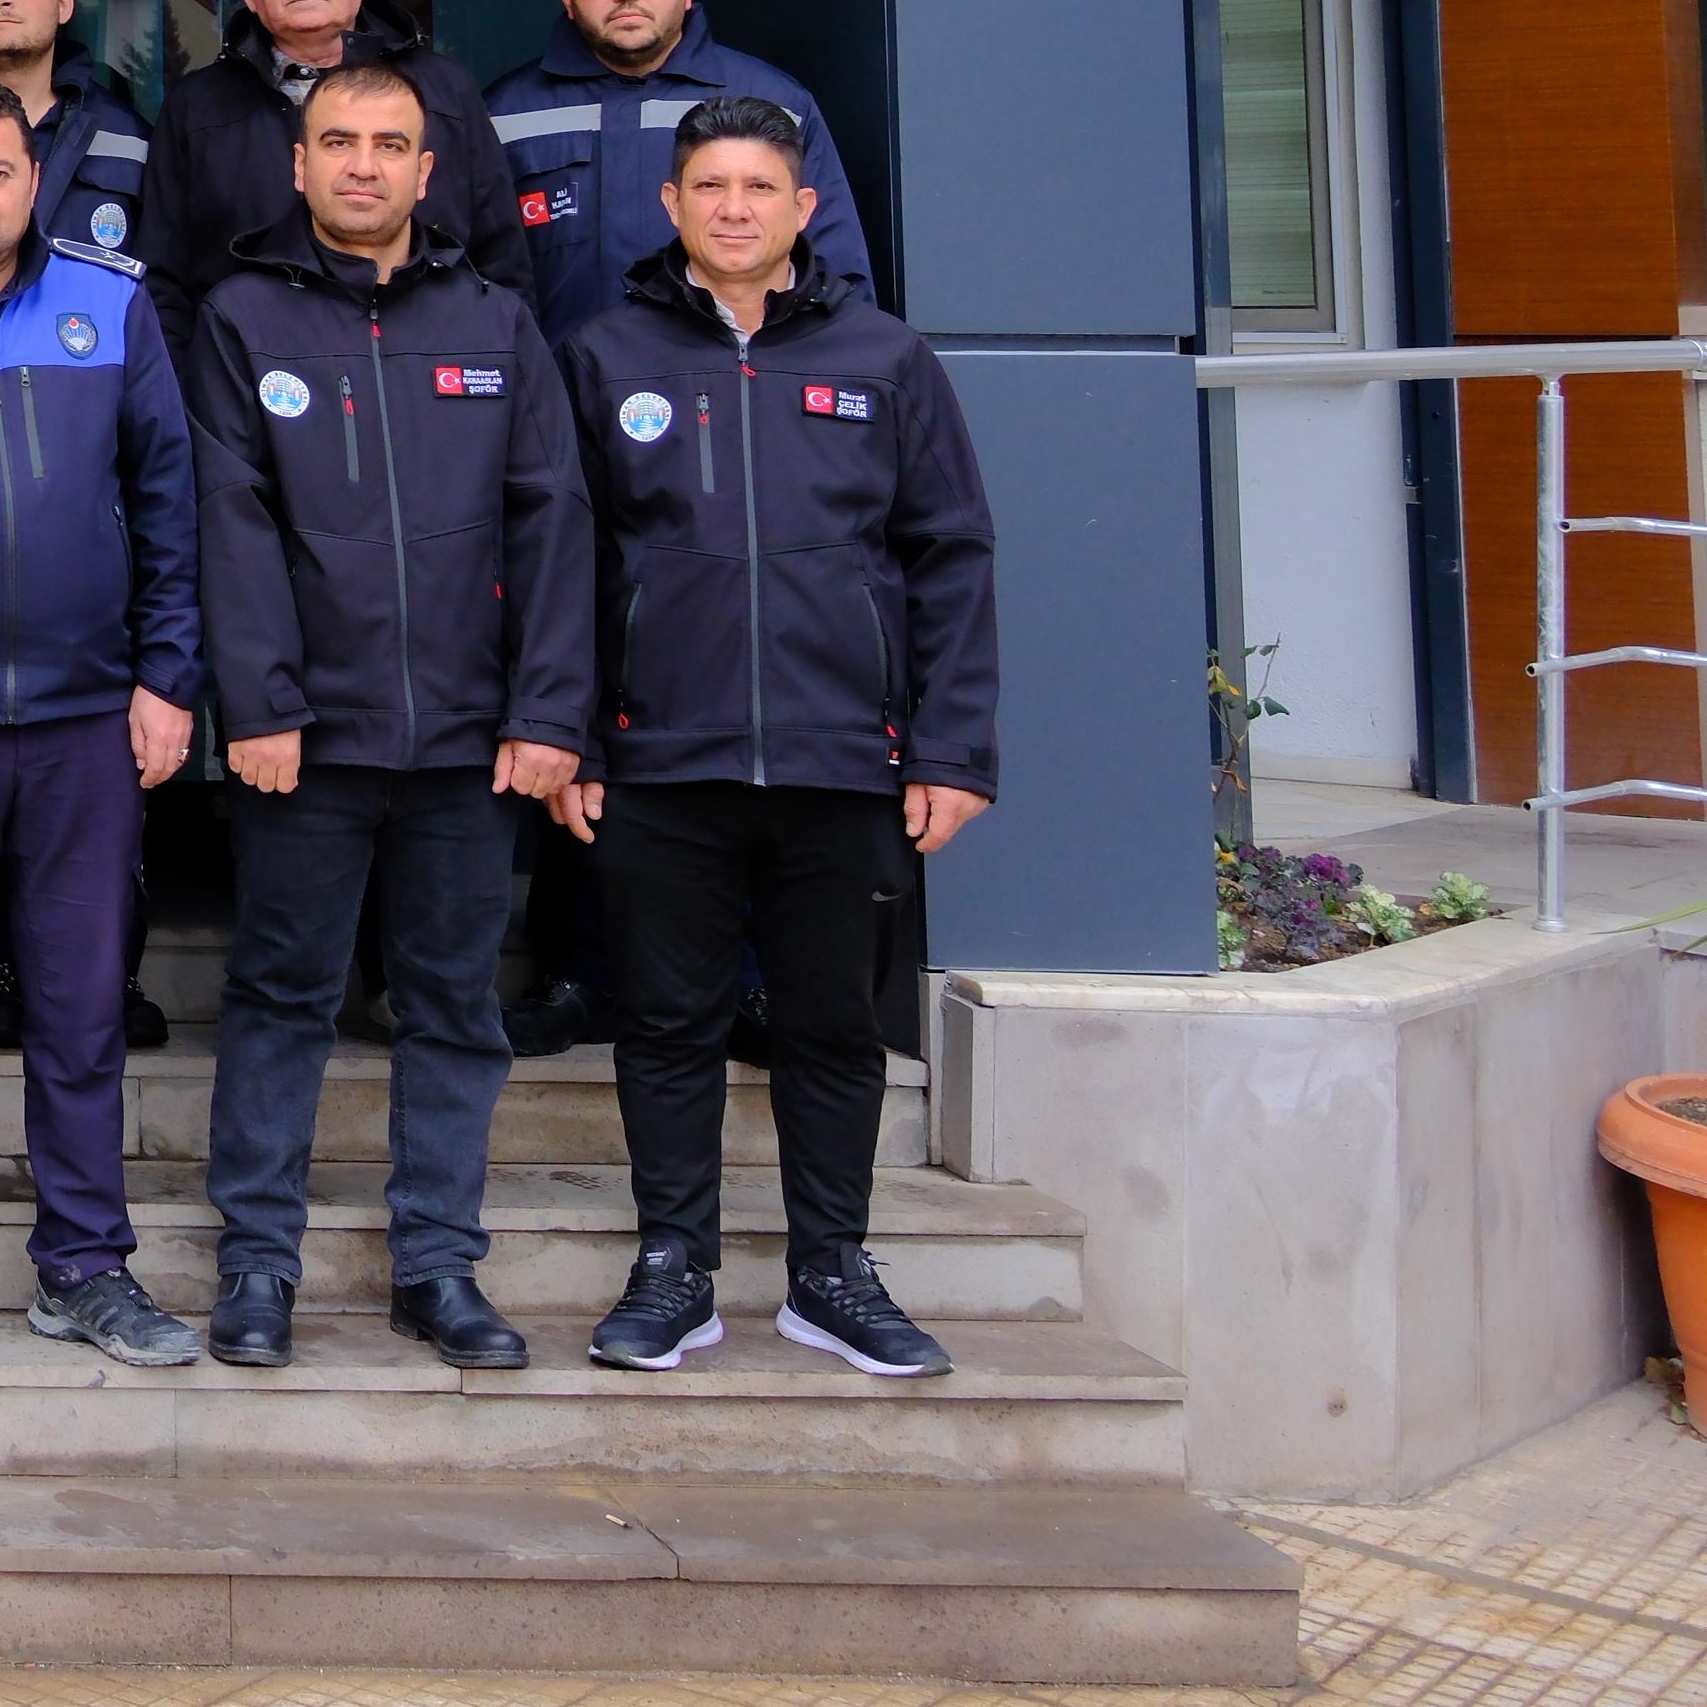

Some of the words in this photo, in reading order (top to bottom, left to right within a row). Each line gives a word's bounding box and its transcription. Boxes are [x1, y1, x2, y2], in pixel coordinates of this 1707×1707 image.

[463, 368, 500, 377] Mehmet
[468, 384, 499, 394] ŞOFÖR
[838, 391, 867, 402] Murat
[838, 399, 867, 411] ÇELİK
